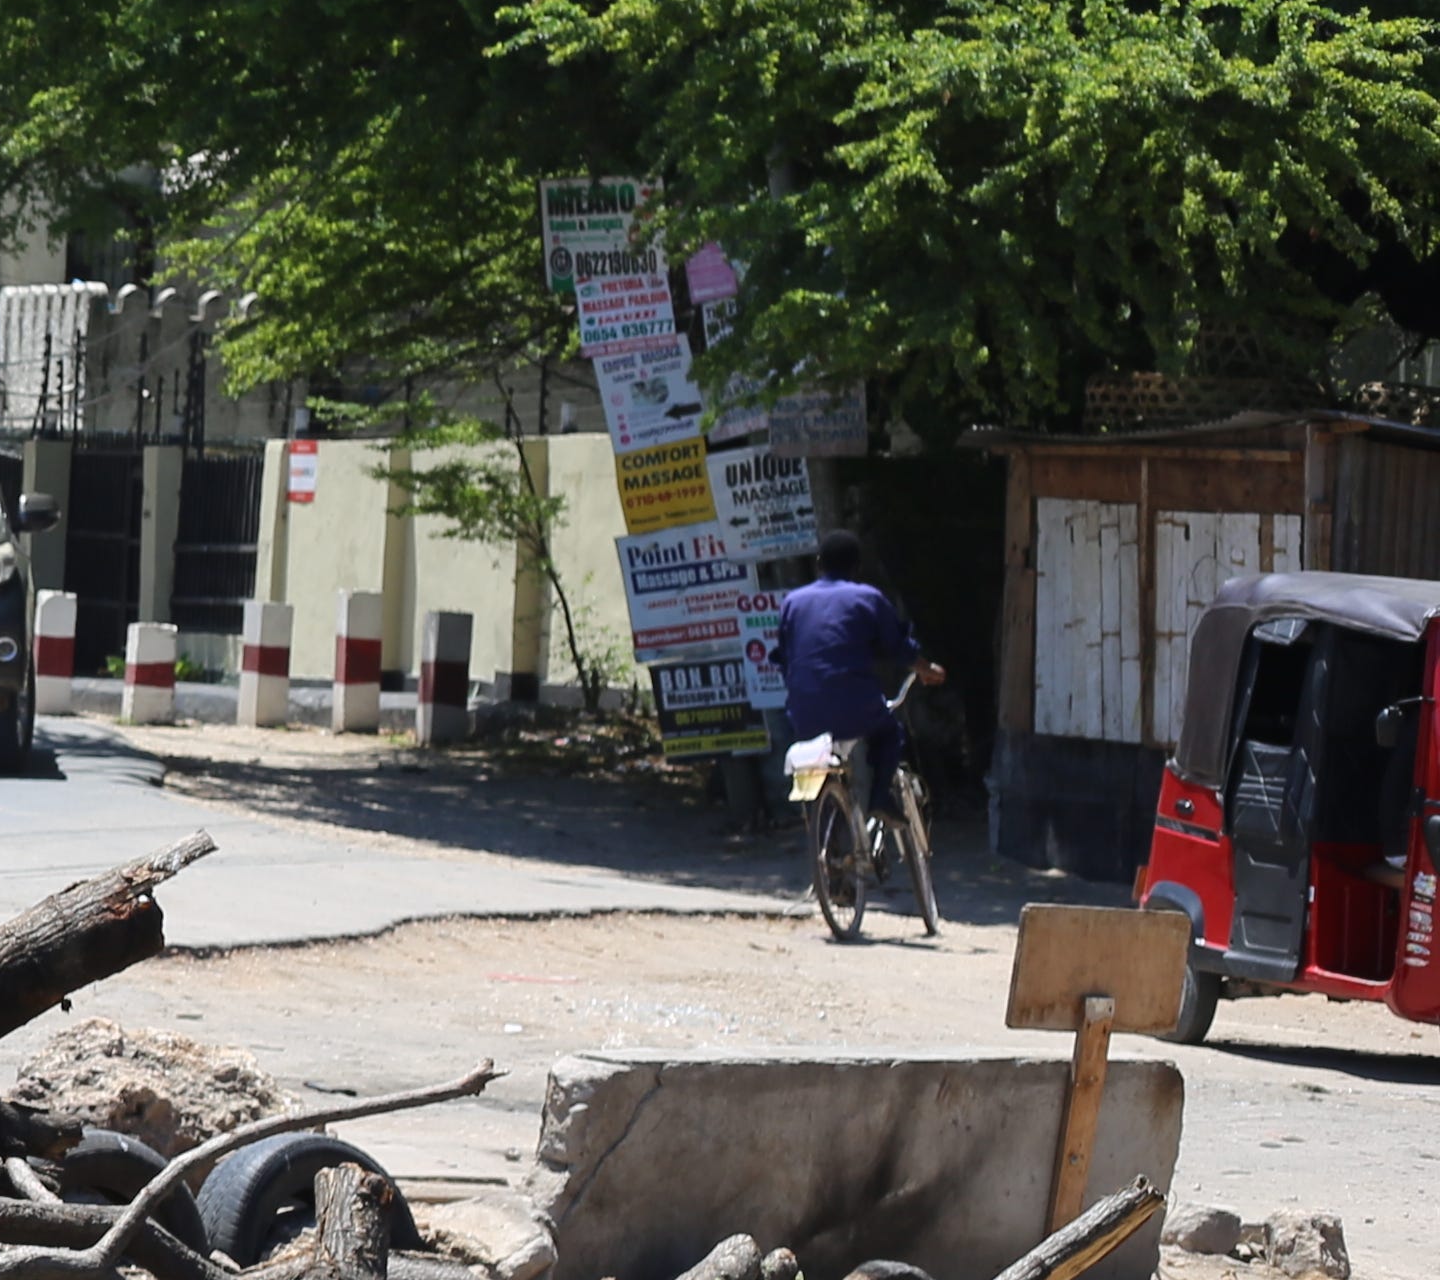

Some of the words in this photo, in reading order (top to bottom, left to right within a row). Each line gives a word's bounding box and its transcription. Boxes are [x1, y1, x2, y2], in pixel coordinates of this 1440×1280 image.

[583, 297, 625, 314] MASSAGE
[629, 291, 668, 306] PARLOUR
[622, 444, 699, 471] COMFORT
[726, 452, 803, 488] UNIQUE
[624, 464, 702, 491] MASSAGE
[733, 479, 808, 507] MASSAGE
[627, 541, 686, 568] Point
[637, 567, 697, 590] Massage
[660, 666, 701, 693] BON
